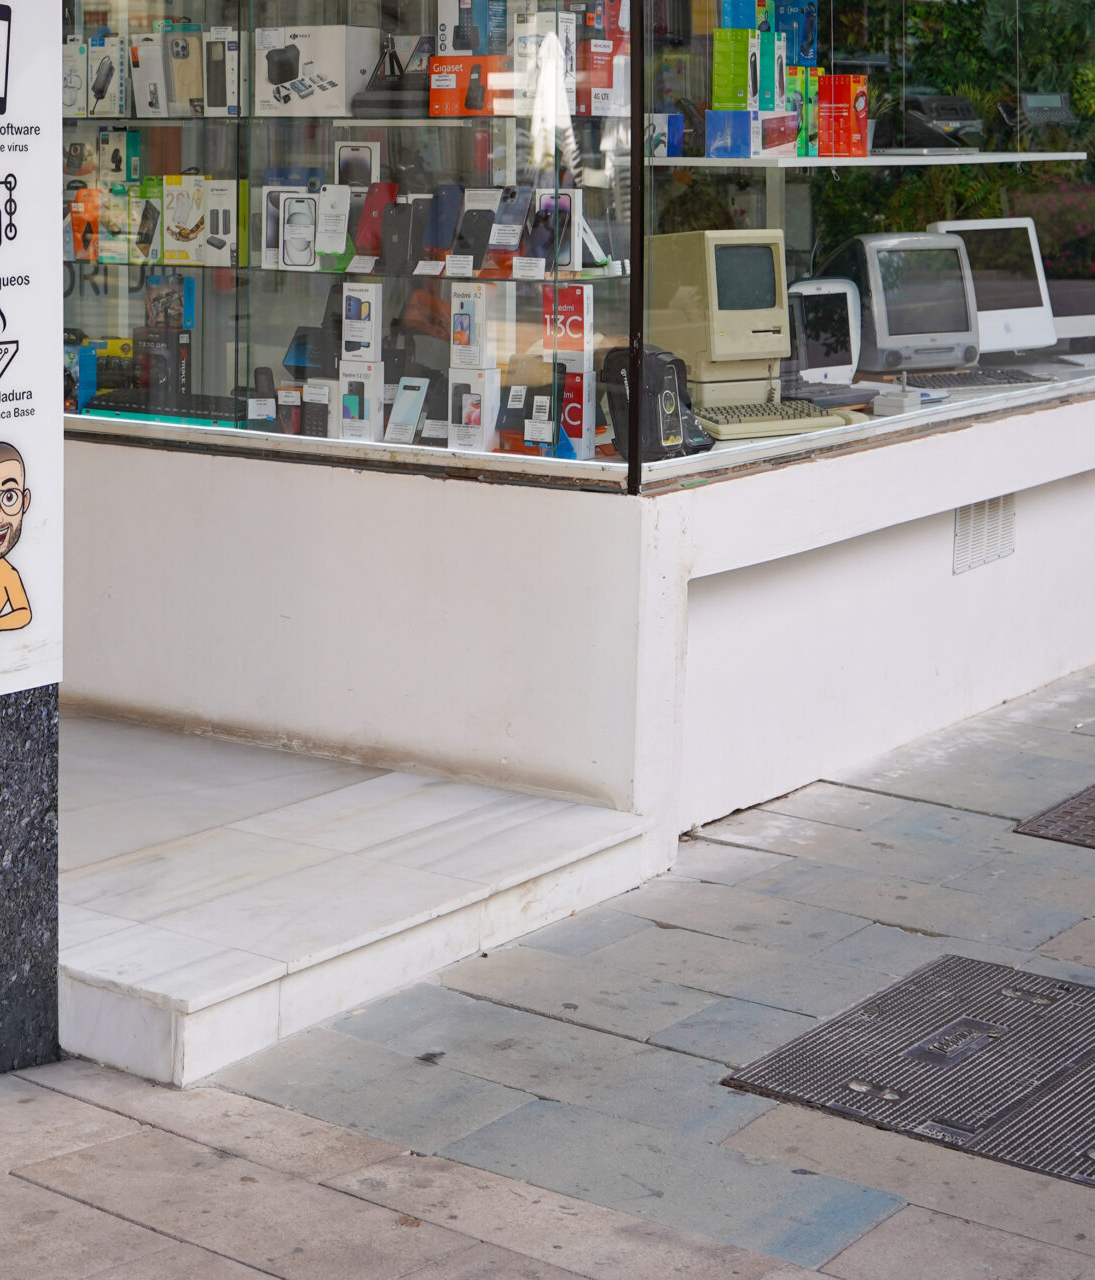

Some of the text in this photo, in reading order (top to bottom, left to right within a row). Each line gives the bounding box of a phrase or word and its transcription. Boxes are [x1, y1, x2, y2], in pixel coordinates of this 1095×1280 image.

[433, 63, 464, 75] Gigaset
[601, 93, 610, 101] LTE
[7, 142, 28, 153] virus
[544, 313, 583, 339] 13C
[14, 406, 35, 418] Base
